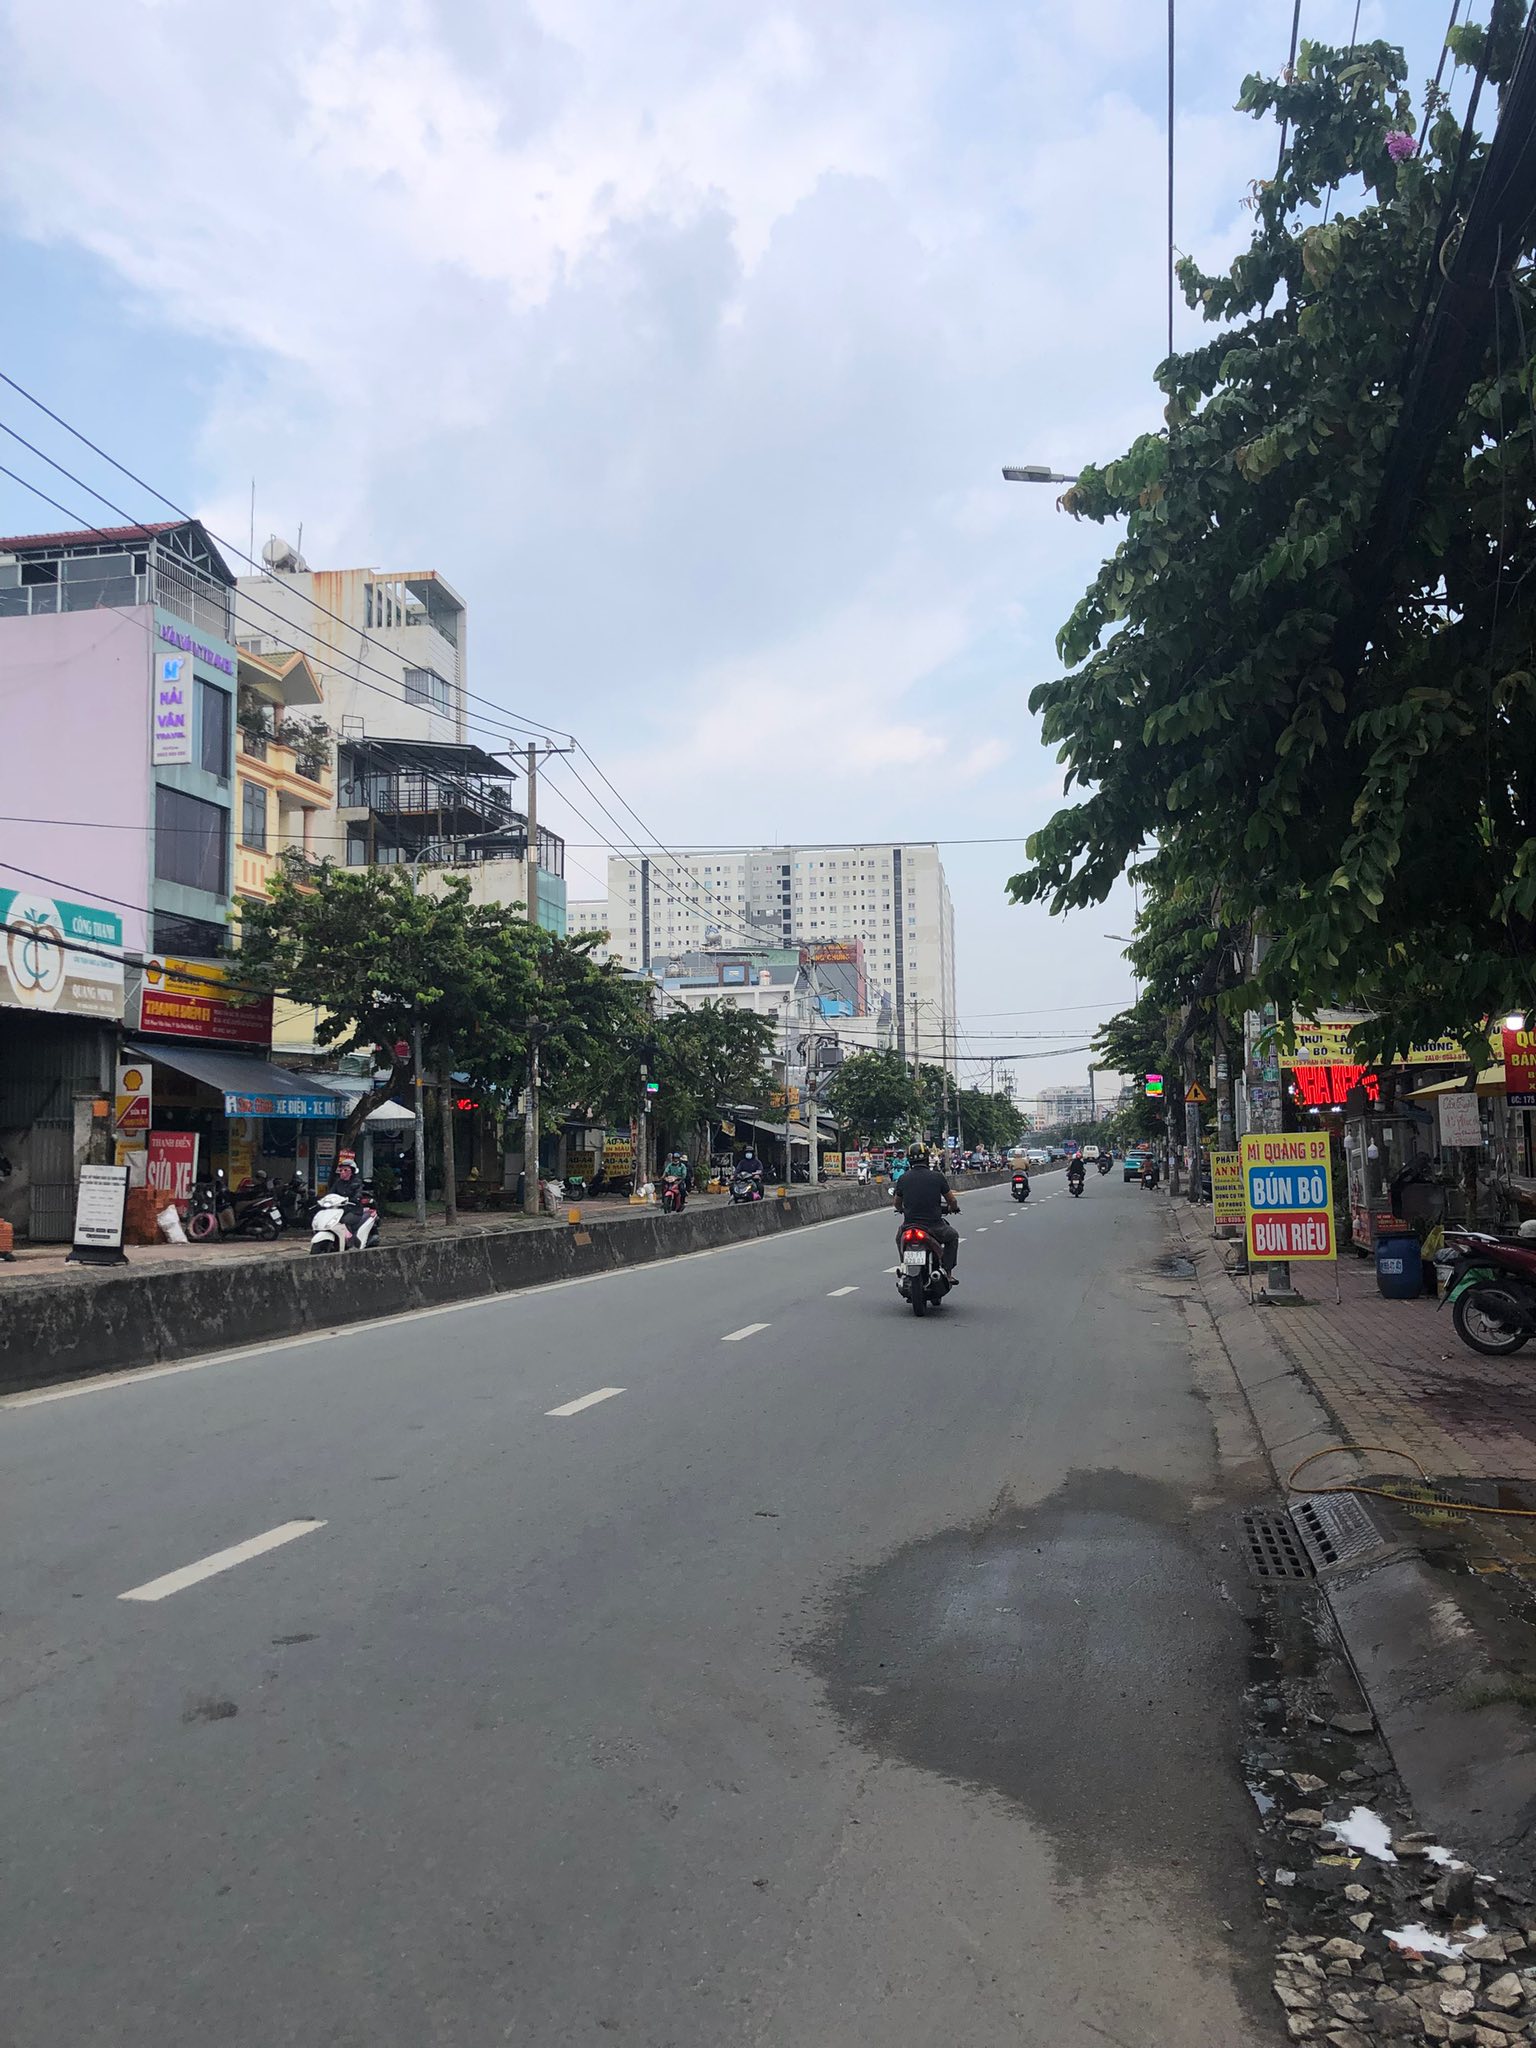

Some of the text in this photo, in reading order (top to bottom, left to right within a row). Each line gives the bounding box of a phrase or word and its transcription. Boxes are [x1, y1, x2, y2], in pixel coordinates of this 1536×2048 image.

[1516, 1030, 1536, 1049] QU
[1310, 1142, 1325, 1159] 92
[174, 1161, 194, 1200] XE
[1253, 1169, 1325, 1206] BÚN BÒ
[1255, 1217, 1327, 1252] BÚN RIÊU
